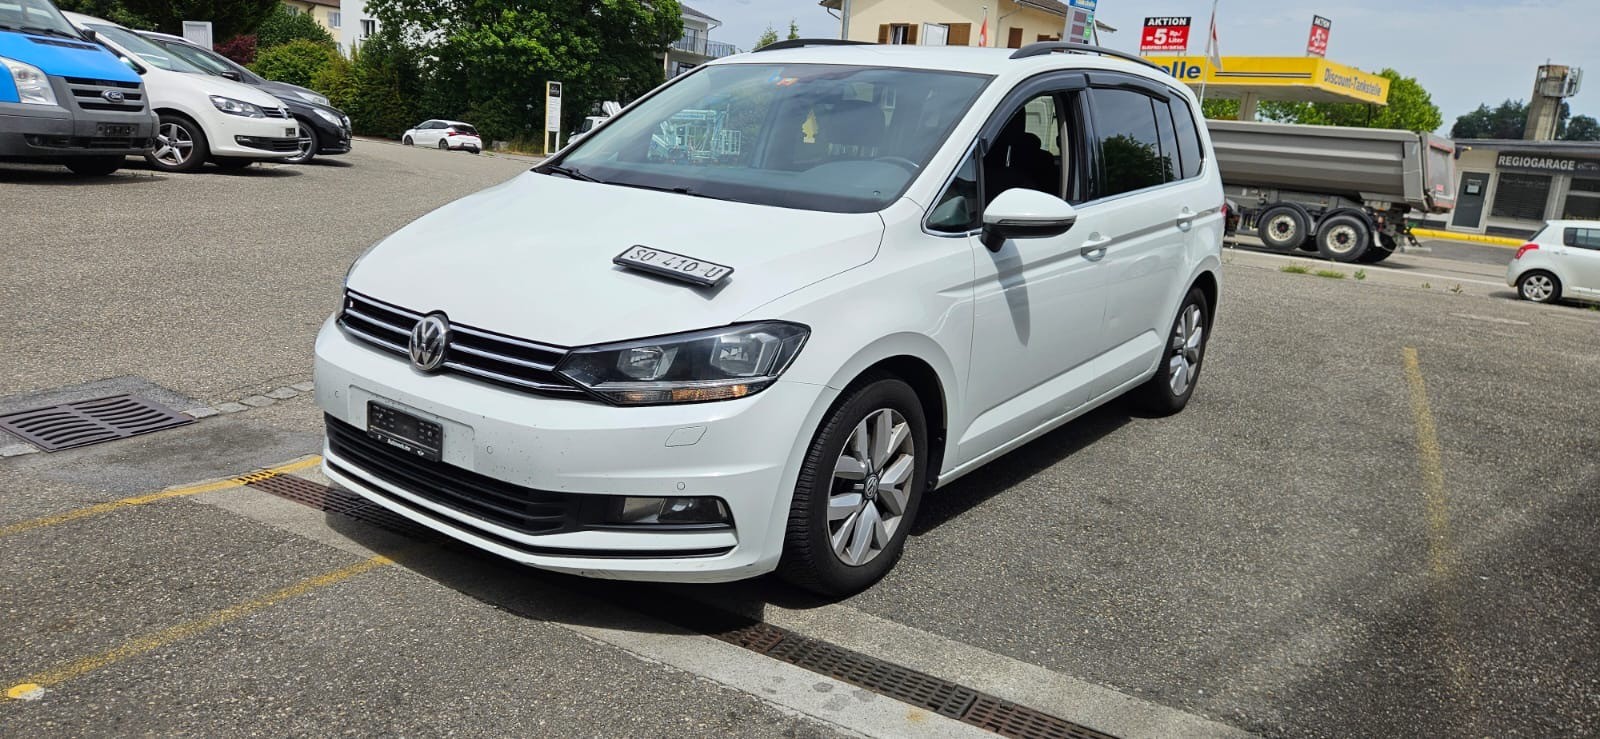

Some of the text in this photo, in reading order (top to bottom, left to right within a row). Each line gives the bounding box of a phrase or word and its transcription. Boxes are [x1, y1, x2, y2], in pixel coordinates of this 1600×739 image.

[1147, 17, 1187, 26] AKTION
[1146, 28, 1168, 45] -5
[1325, 68, 1381, 96] Discount-Tankstelle
[1498, 156, 1575, 170] REGIOGARAGE
[662, 256, 699, 272] 410
[704, 267, 723, 278] U
